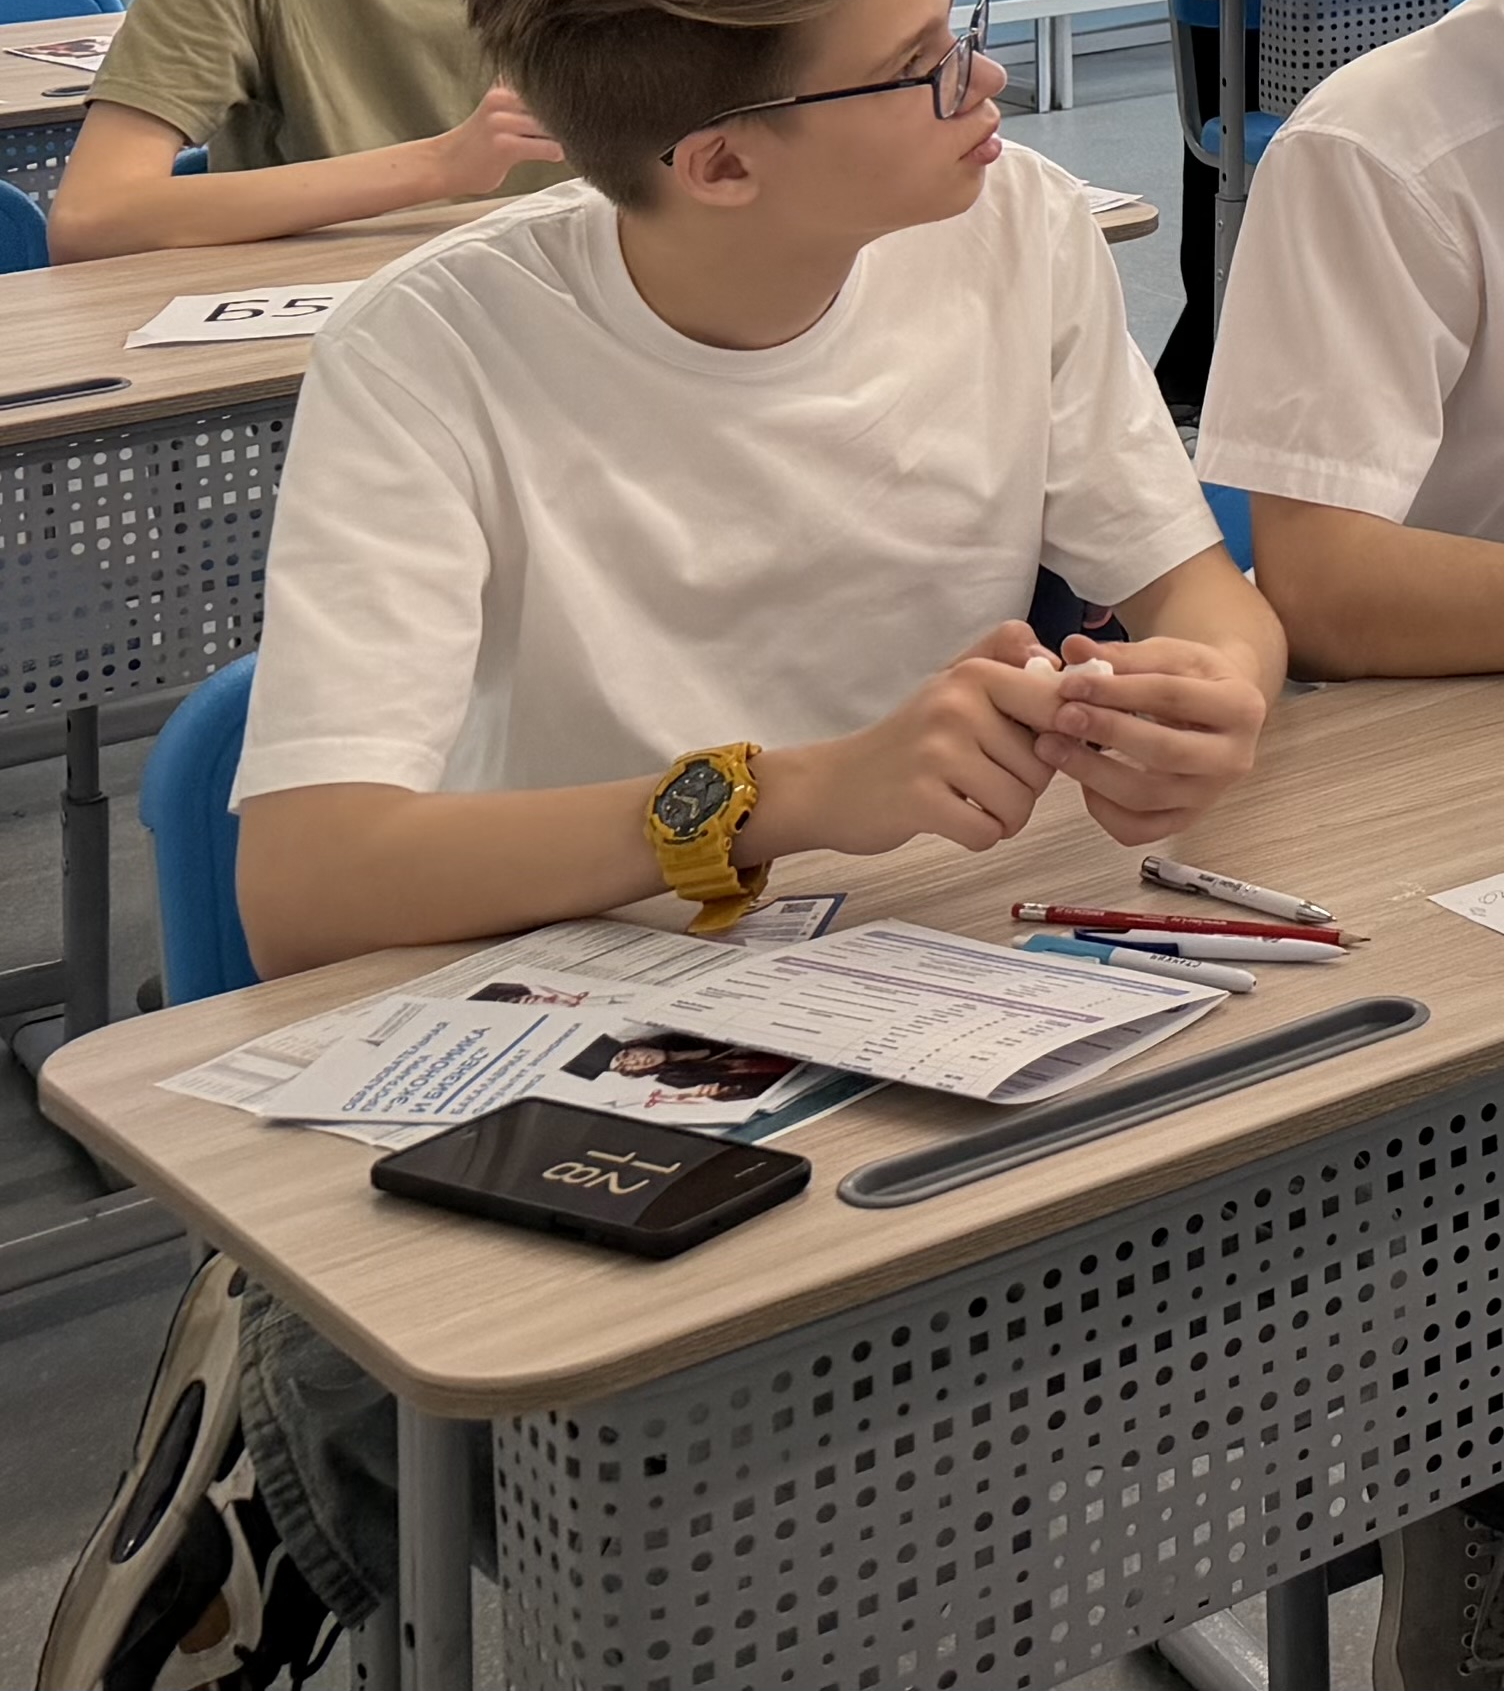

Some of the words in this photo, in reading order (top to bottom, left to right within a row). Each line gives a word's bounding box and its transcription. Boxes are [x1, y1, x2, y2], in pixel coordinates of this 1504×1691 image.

[342, 1021, 450, 1112] ОБРАЗОВАТЕЛЬНАЯ
[359, 1054, 433, 1112] ПРОГРАММА
[450, 1048, 531, 1115] БАКАЛАВРИАТ
